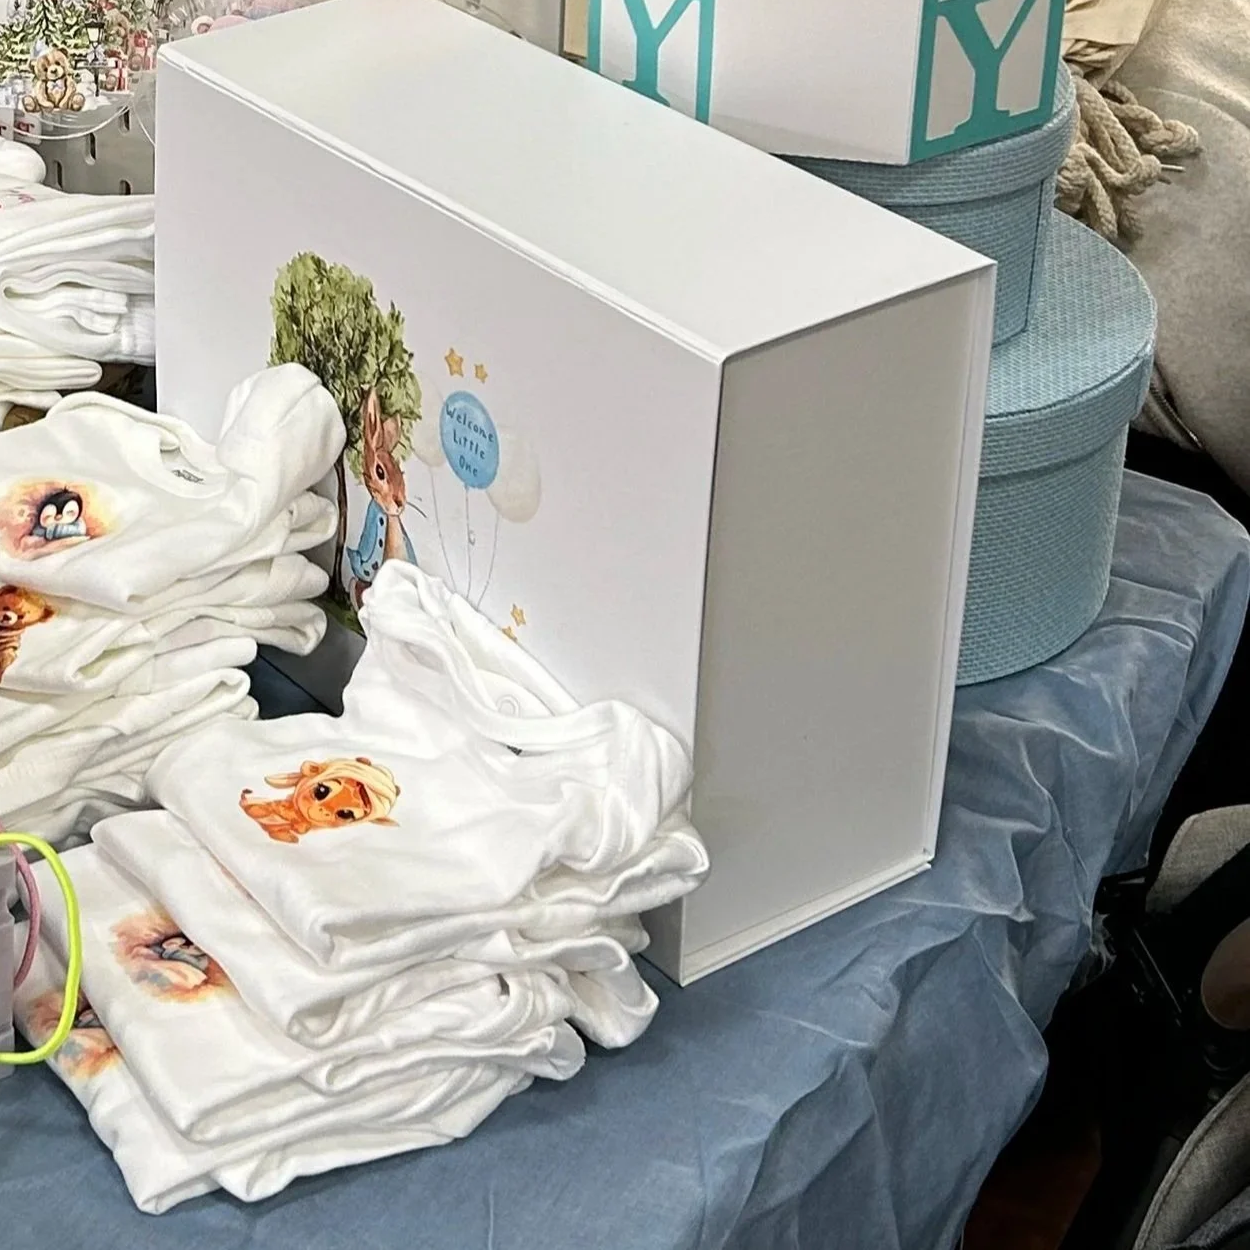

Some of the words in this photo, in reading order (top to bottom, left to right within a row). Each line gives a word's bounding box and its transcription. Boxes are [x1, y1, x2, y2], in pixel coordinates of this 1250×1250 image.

[445, 403, 494, 443] Welcome
[453, 429, 485, 460] Little
[458, 455, 478, 477] One
